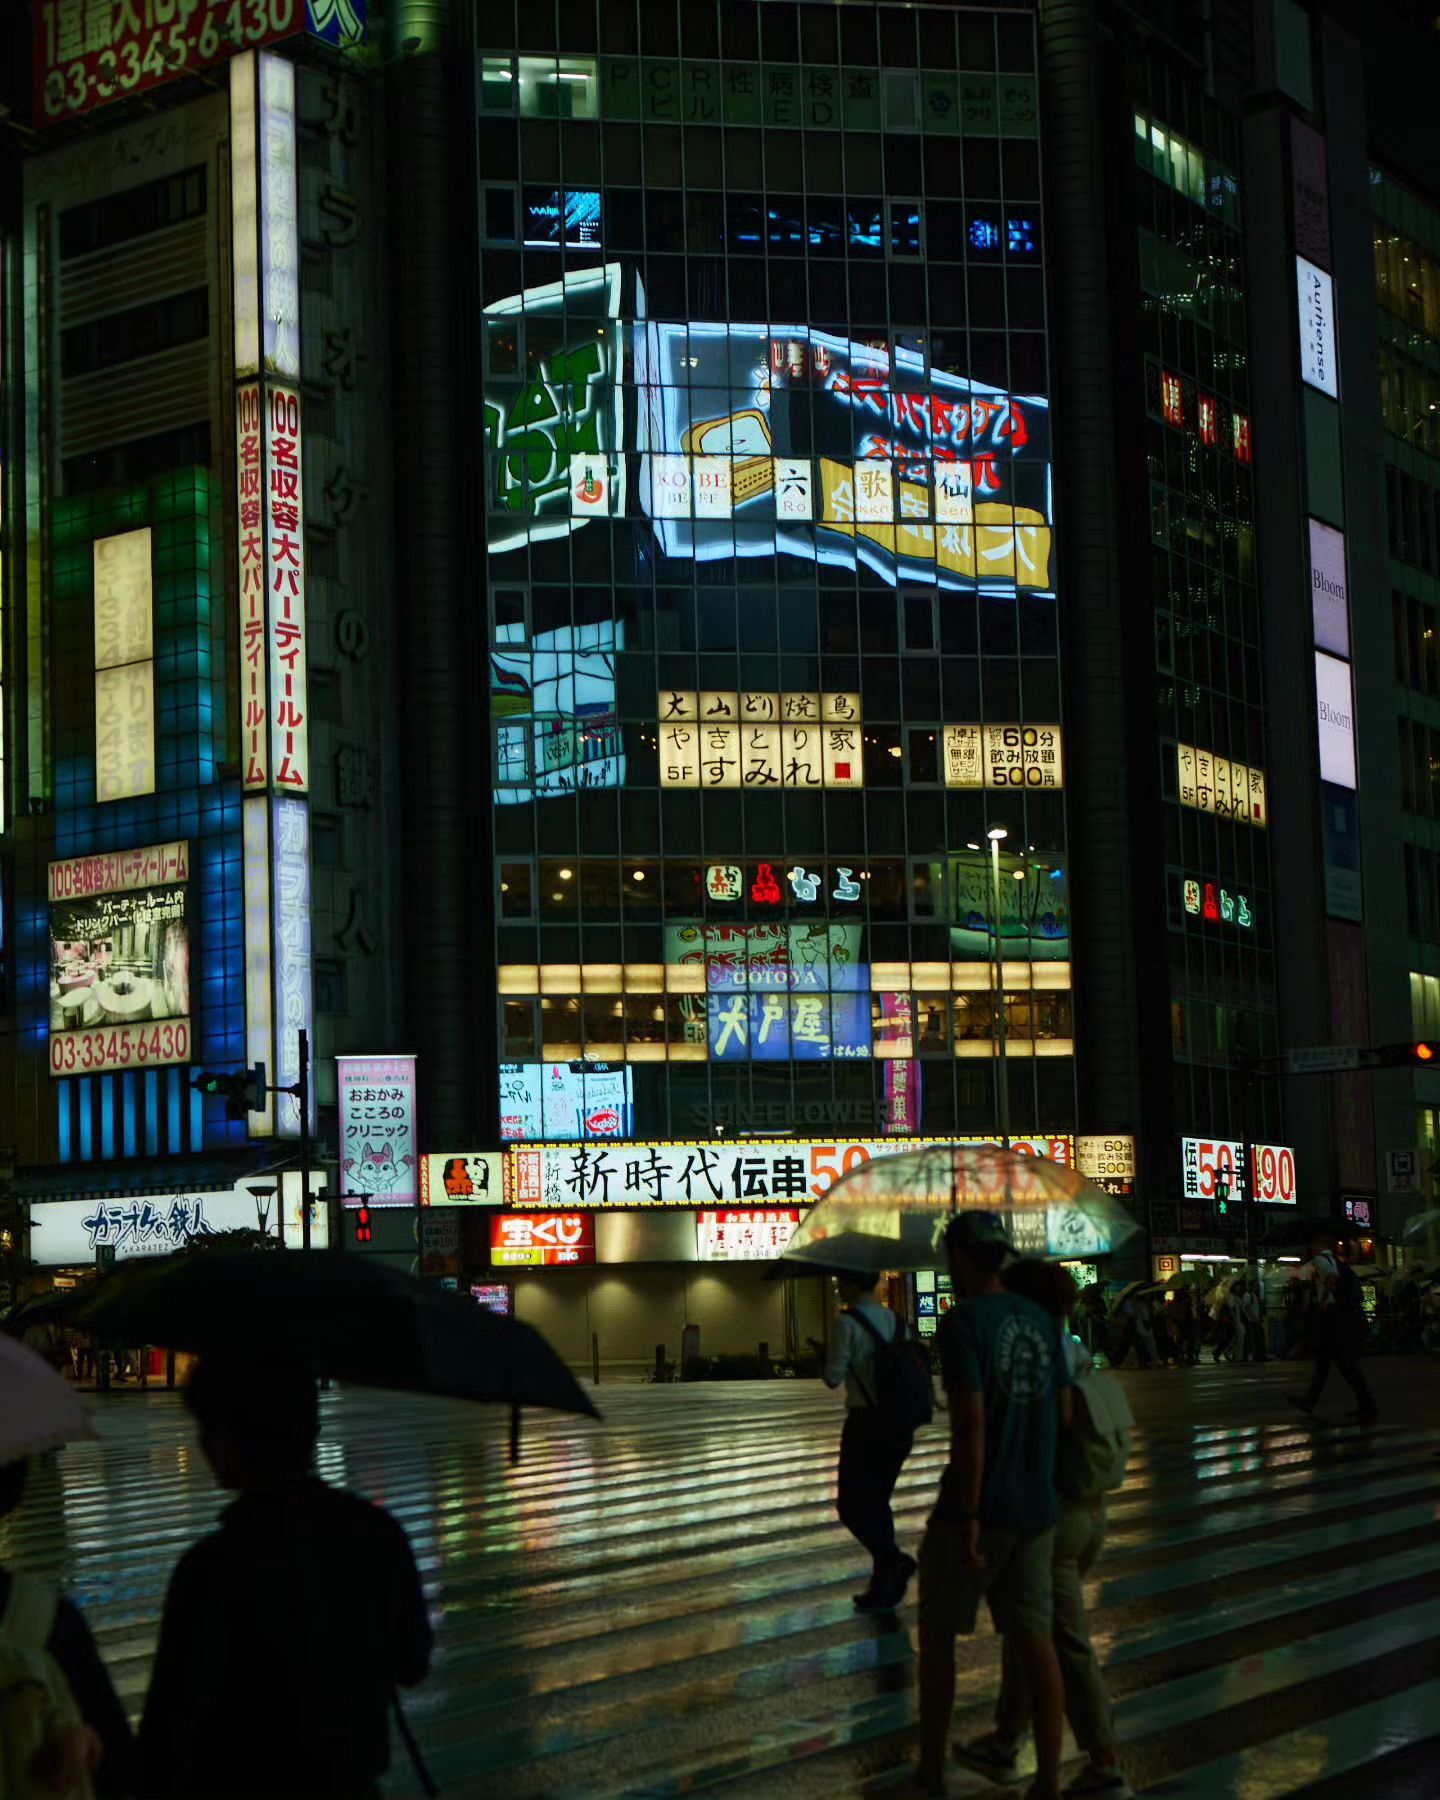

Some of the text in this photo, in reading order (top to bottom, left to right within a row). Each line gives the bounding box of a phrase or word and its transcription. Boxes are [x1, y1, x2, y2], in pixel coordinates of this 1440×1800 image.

[238, 388, 264, 785] 100名収容大パーティールーム
[268, 388, 304, 785] 100名収容大パーティールーム
[1313, 568, 1345, 600] Bloom
[1319, 701, 1351, 729] Bloom
[667, 727, 856, 751] やきとり家
[1003, 728, 1055, 748] 60分
[668, 757, 820, 785] 5F すみれ
[990, 750, 1056, 764] 飲み放題
[1197, 783, 1249, 821] すみれ
[50, 845, 186, 898] 100名収容大パーティールーム
[733, 969, 817, 985] OOTOYA
[714, 995, 831, 1057] 大戸屋
[349, 1087, 405, 1102] おおかみ
[350, 1106, 405, 1120] こころの
[346, 1125, 409, 1139] クリニック
[564, 1147, 724, 1204] 新時代
[731, 1155, 807, 1199] 伝串
[82, 1194, 216, 1248] カラオケの鉄人
[501, 1217, 582, 1246] 宝くじ
